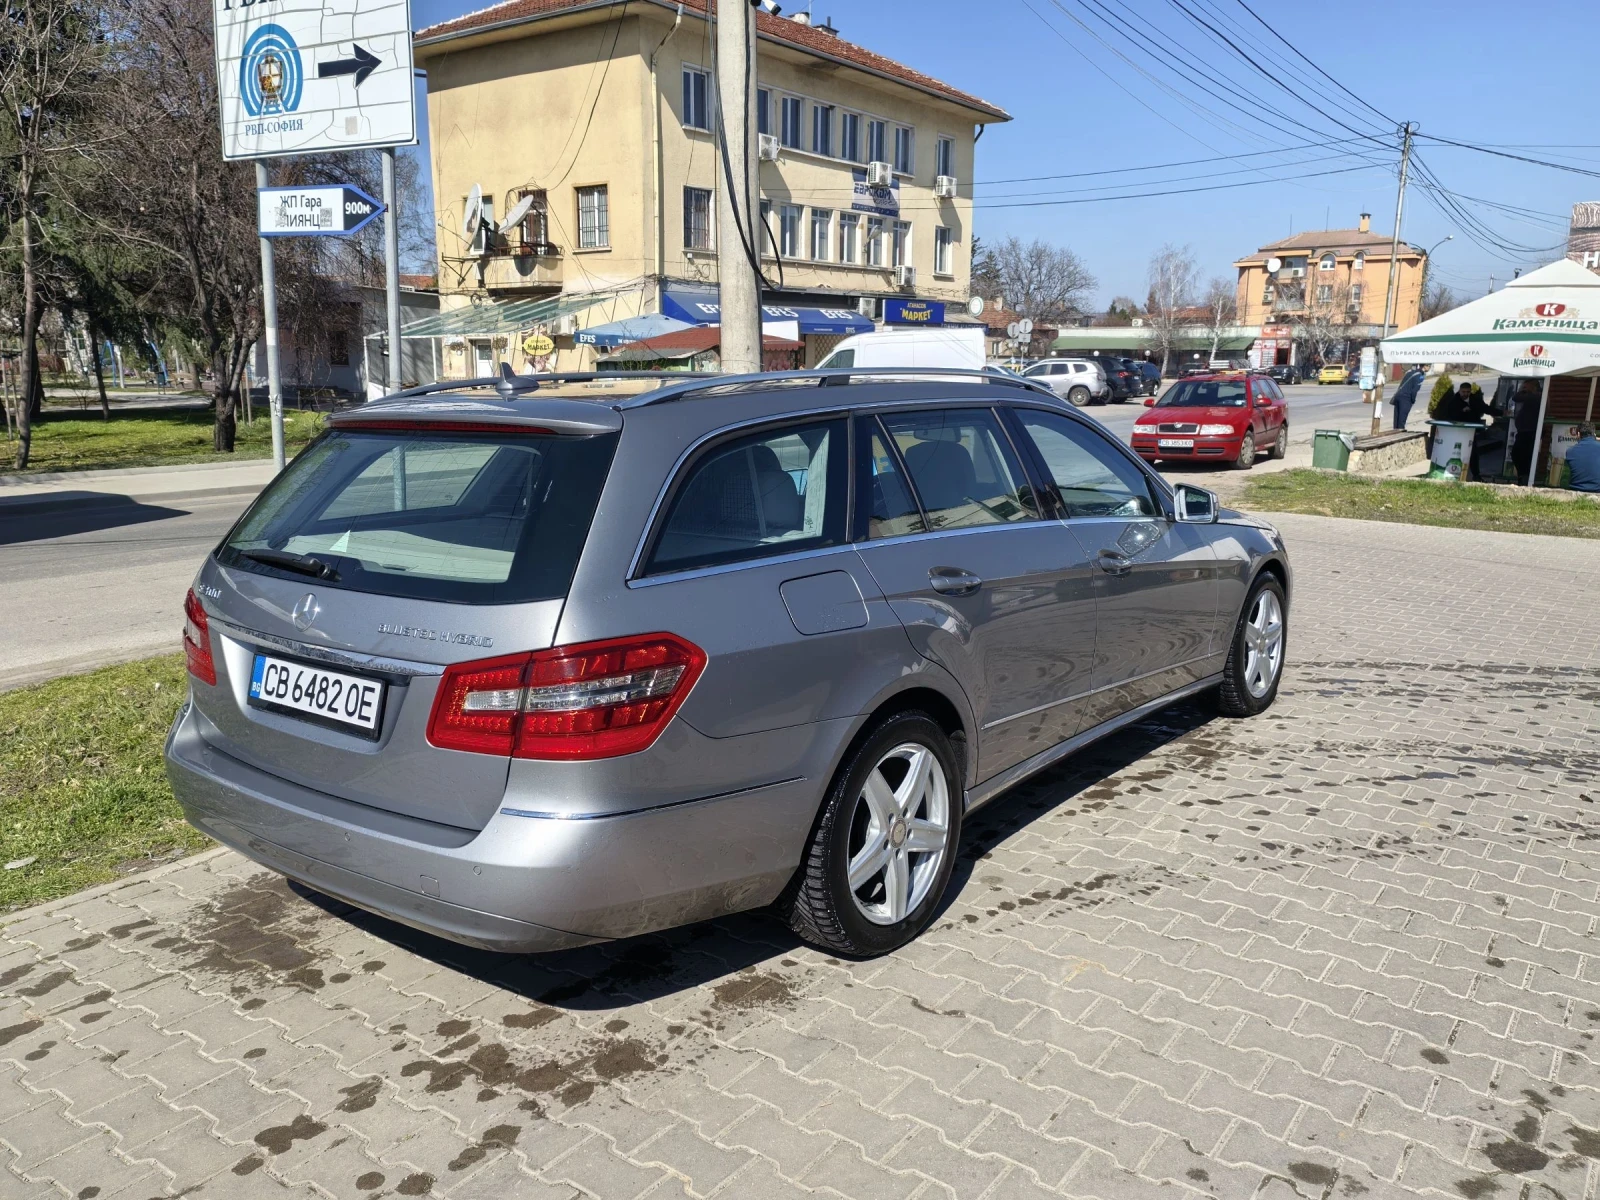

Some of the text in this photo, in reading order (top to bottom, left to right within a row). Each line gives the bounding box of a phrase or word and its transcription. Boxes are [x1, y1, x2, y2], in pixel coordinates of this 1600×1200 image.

[245, 119, 303, 136] РВП-СОФИЯ
[280, 195, 321, 211] ЖП Гара
[819, 309, 853, 319] EFES
[1492, 319, 1598, 331] Каменица
[580, 333, 596, 343] EFES
[1513, 358, 1556, 368] Каменица
[378, 624, 494, 648] BLUETEC HYBRID
[252, 681, 261, 692] BG
